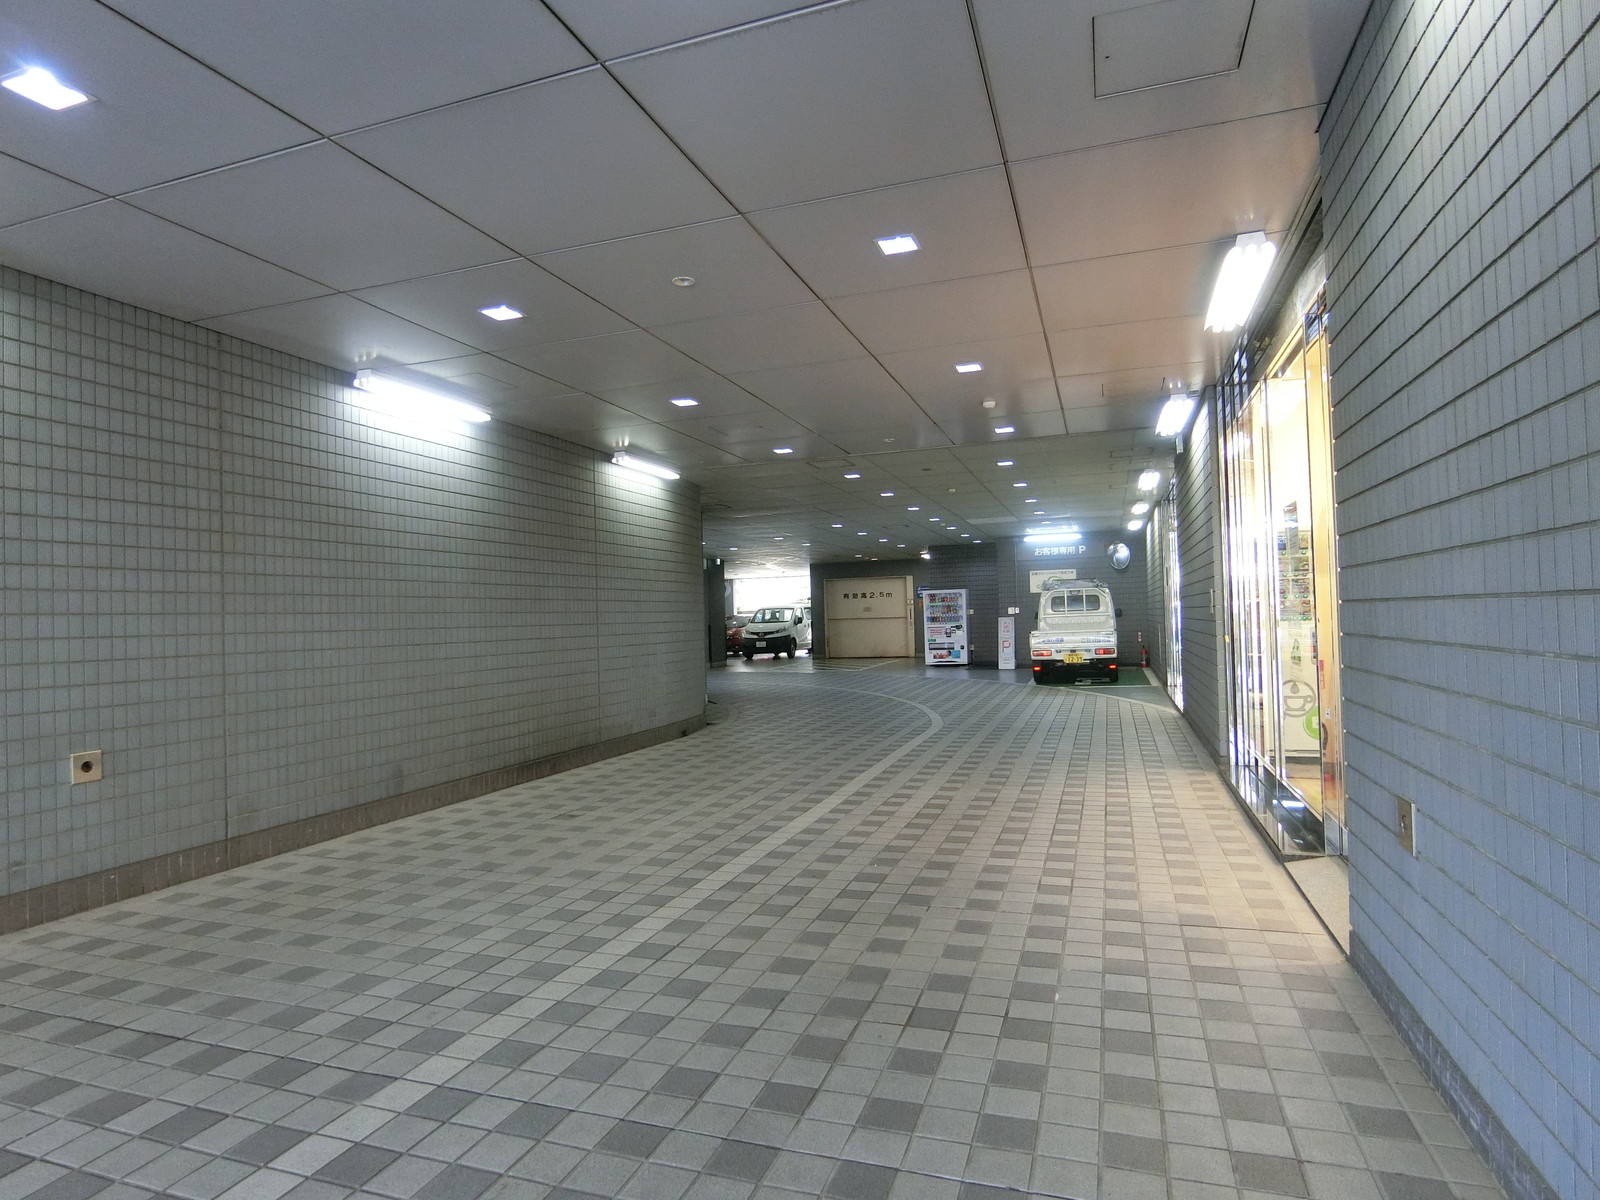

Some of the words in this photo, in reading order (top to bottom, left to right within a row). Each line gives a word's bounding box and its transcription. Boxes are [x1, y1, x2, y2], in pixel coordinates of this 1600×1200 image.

[1034, 546, 1076, 556] お客様専用
[1078, 545, 1086, 555] P
[1002, 640, 1011, 653] P
